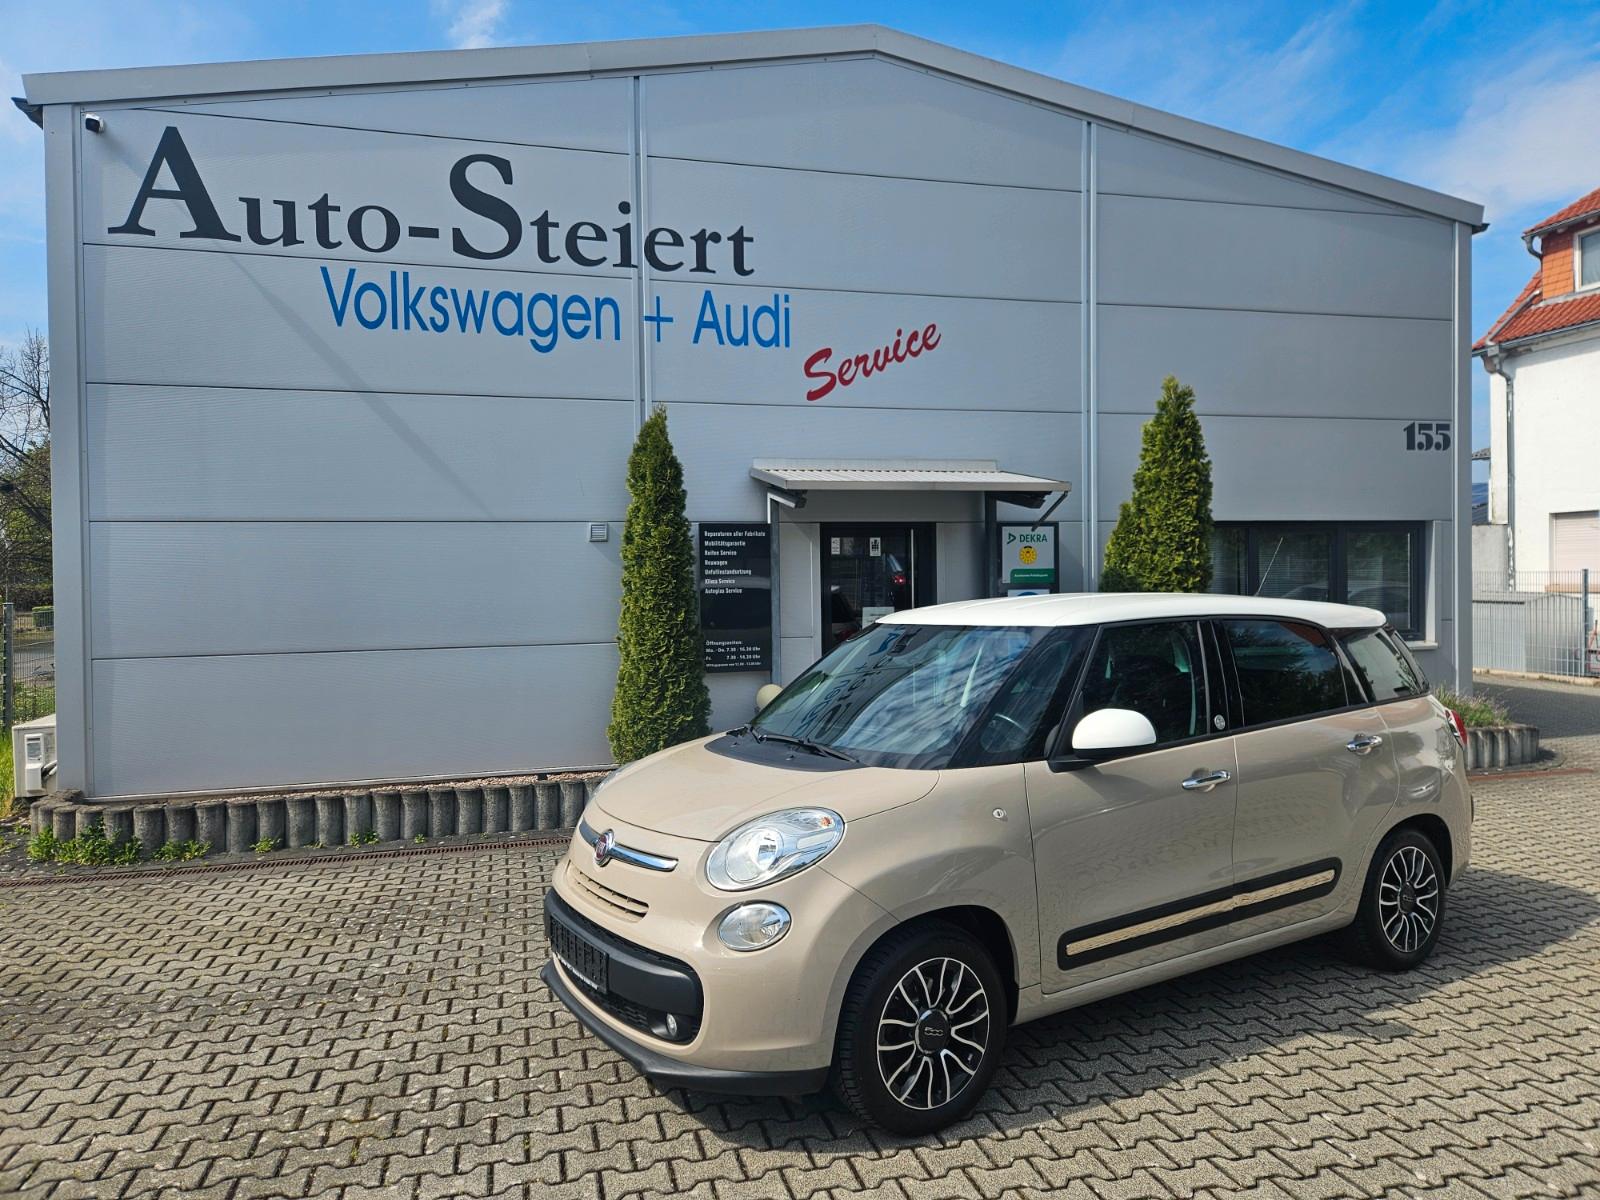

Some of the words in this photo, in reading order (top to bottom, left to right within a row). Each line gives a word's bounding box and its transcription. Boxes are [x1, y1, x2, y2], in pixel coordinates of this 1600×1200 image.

[107, 126, 755, 278] Auto-Steiert
[319, 265, 622, 354] Volkswagen
[691, 288, 793, 350] Audi
[803, 323, 942, 402] Service
[1403, 421, 1451, 451] 155
[1019, 534, 1048, 543] DEKRA
